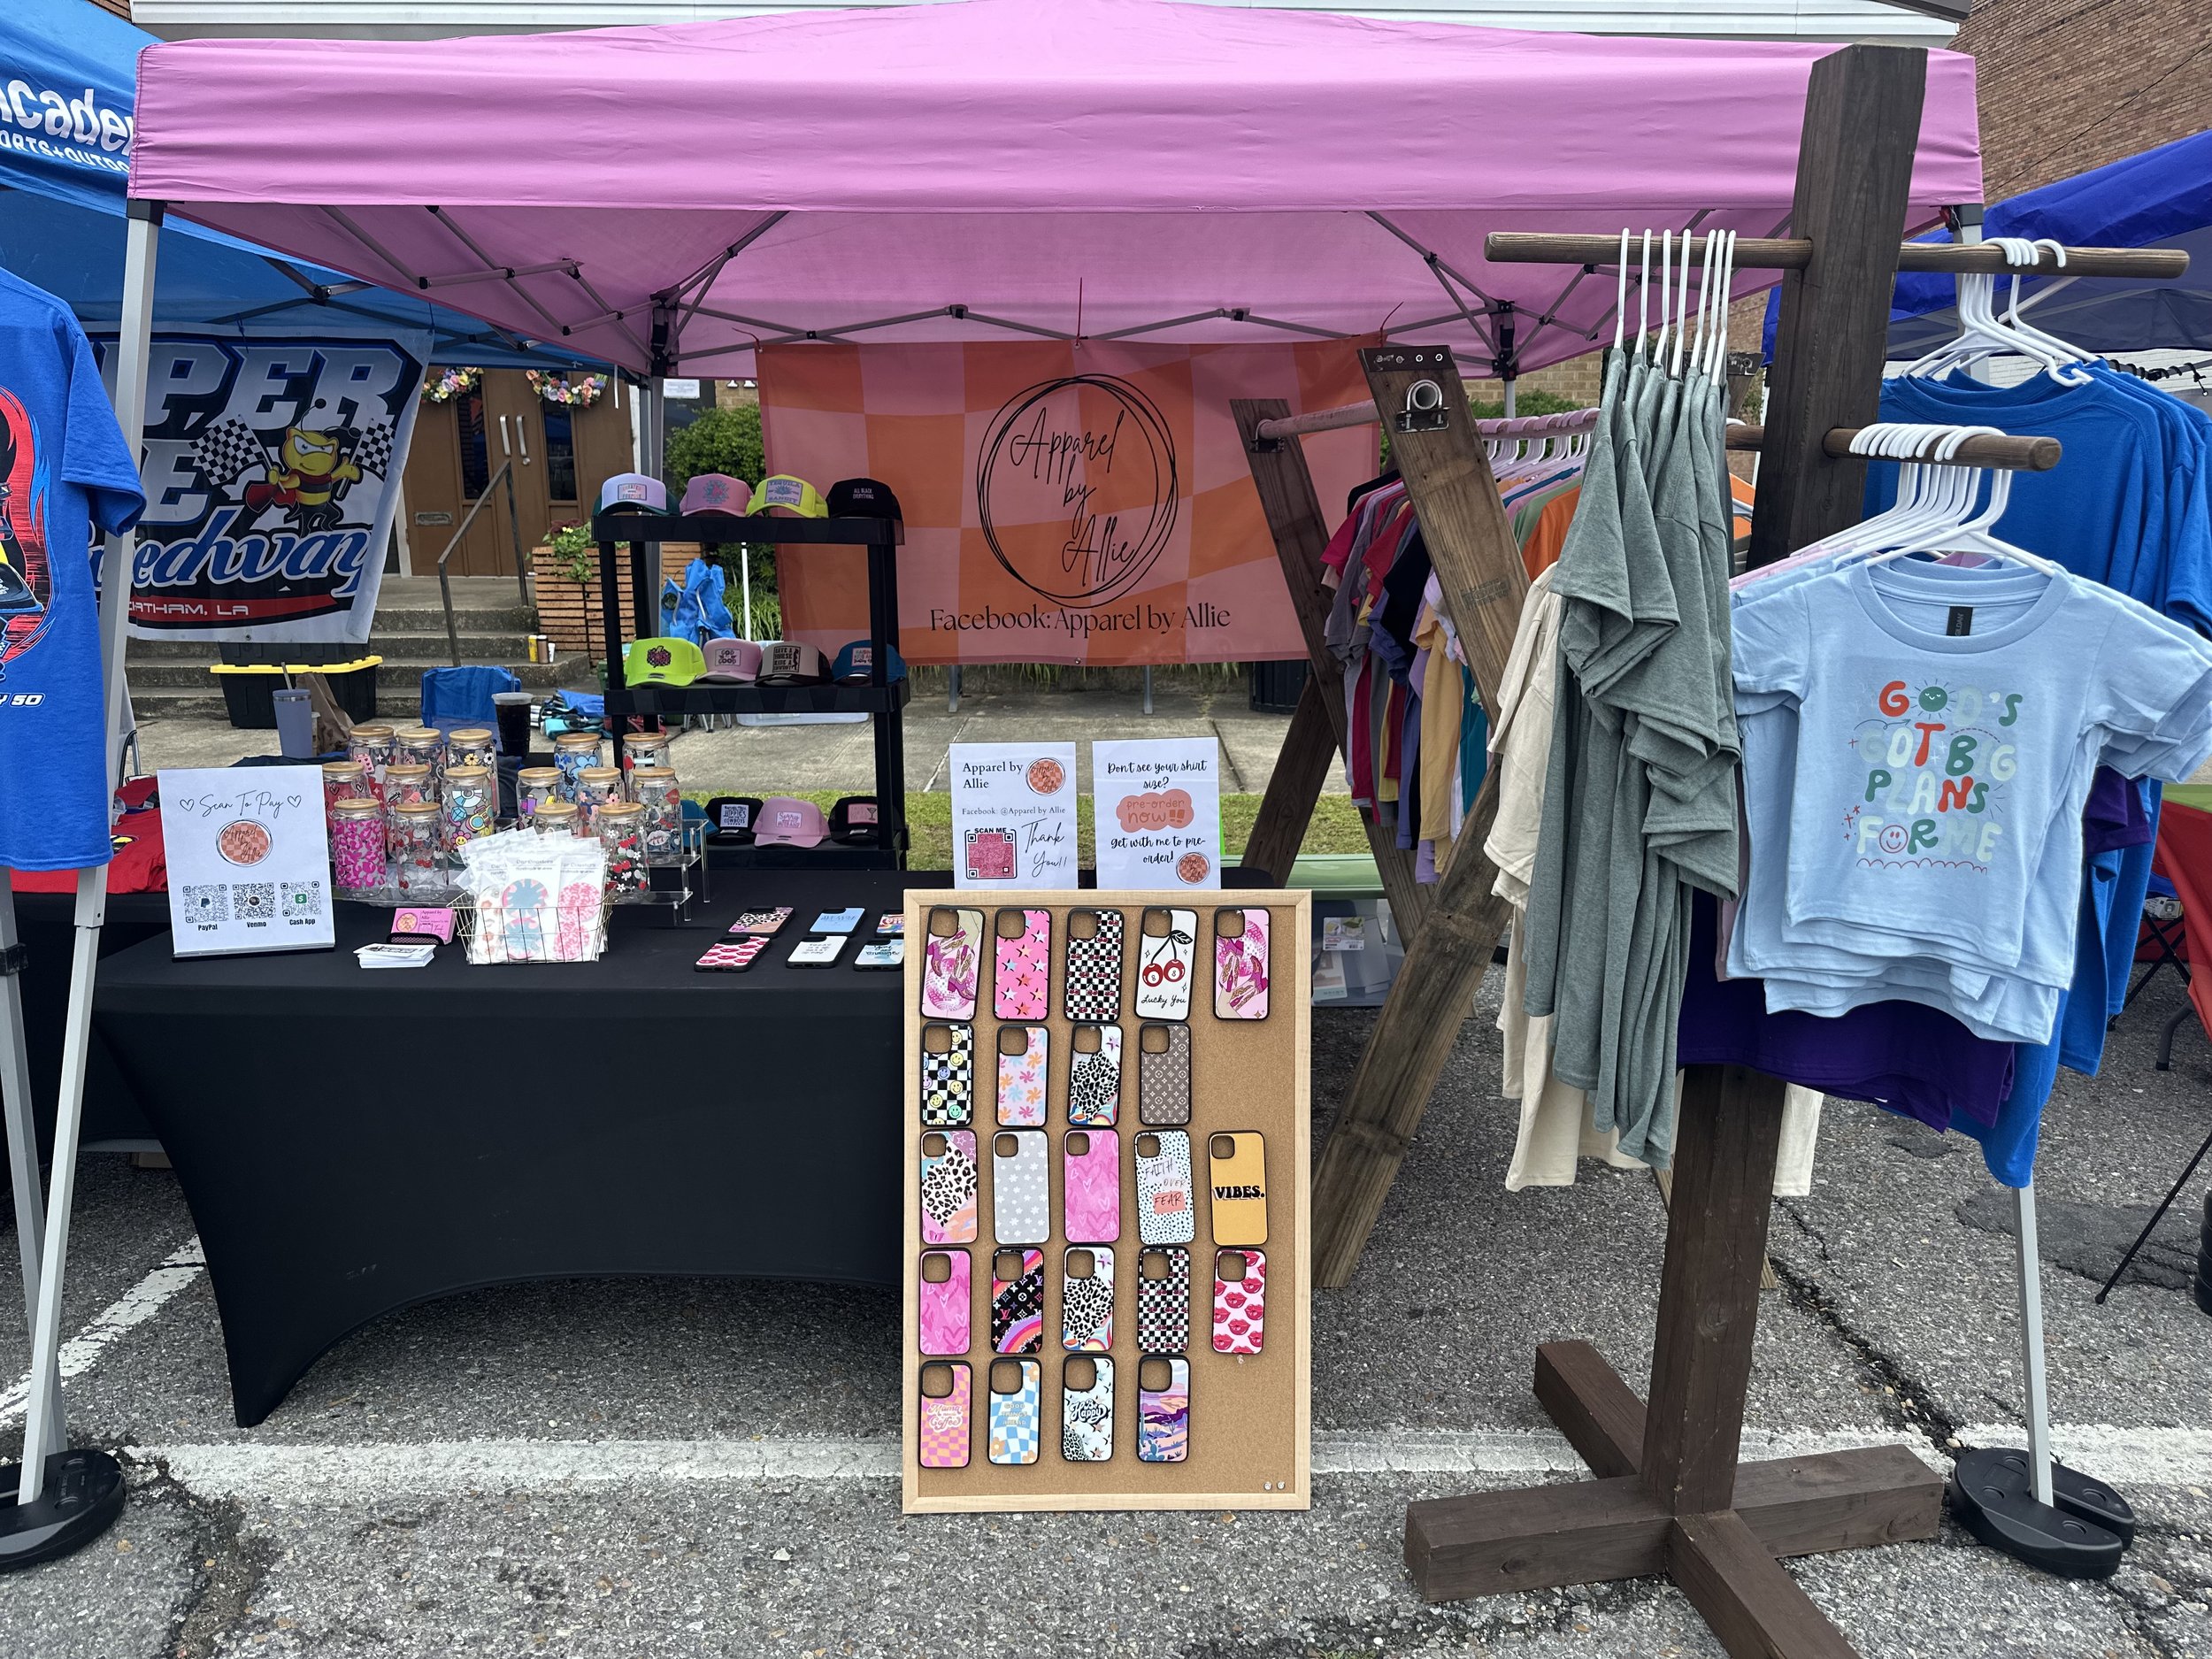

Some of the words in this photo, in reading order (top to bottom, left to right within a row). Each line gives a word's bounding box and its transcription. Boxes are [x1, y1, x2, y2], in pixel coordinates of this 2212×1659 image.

[1010, 407, 1125, 485] Apparel
[1063, 453, 1097, 540] by
[1062, 514, 1134, 588] Allie
[217, 605, 249, 616] LA
[930, 603, 1050, 632] Facebook:
[1055, 605, 1141, 639] Apparel
[1148, 604, 1175, 634] by
[1180, 603, 1232, 628] Allie
[11, 695, 43, 706] 50
[1858, 722, 1947, 768] GOT
[1945, 734, 2016, 781] BIG
[963, 762, 1006, 775] Apparel
[1010, 762, 1024, 775] by
[1155, 763, 1179, 774] your
[1180, 760, 1208, 772] shirt
[963, 779, 989, 789] Allie
[1143, 776, 1170, 789] size?
[1864, 769, 1990, 815] PLANS
[199, 794, 233, 817] Scan
[235, 789, 257, 816] To
[256, 791, 284, 818] Pay
[1126, 798, 1185, 810] pre-order
[1000, 807, 1035, 816] @Apparel
[1021, 818, 1065, 854] Thank
[1110, 837, 1128, 849] get
[1130, 836, 1154, 848] with
[1172, 836, 1183, 846] to
[1186, 837, 1206, 849] pre-
[1856, 815, 1939, 855] FOR
[1939, 817, 2002, 863] ME
[1143, 850, 1174, 864] order!
[1141, 995, 1168, 1009] Lucky
[1171, 995, 1187, 1007] You
[1145, 1158, 1173, 1178] FAITH
[1155, 1194, 1182, 1206] FEAR
[1213, 1186, 1265, 1200] VIBES.
[928, 1403, 961, 1414] Mama
[1069, 1401, 1109, 1425] Happy
[930, 1417, 962, 1431] Coffee
